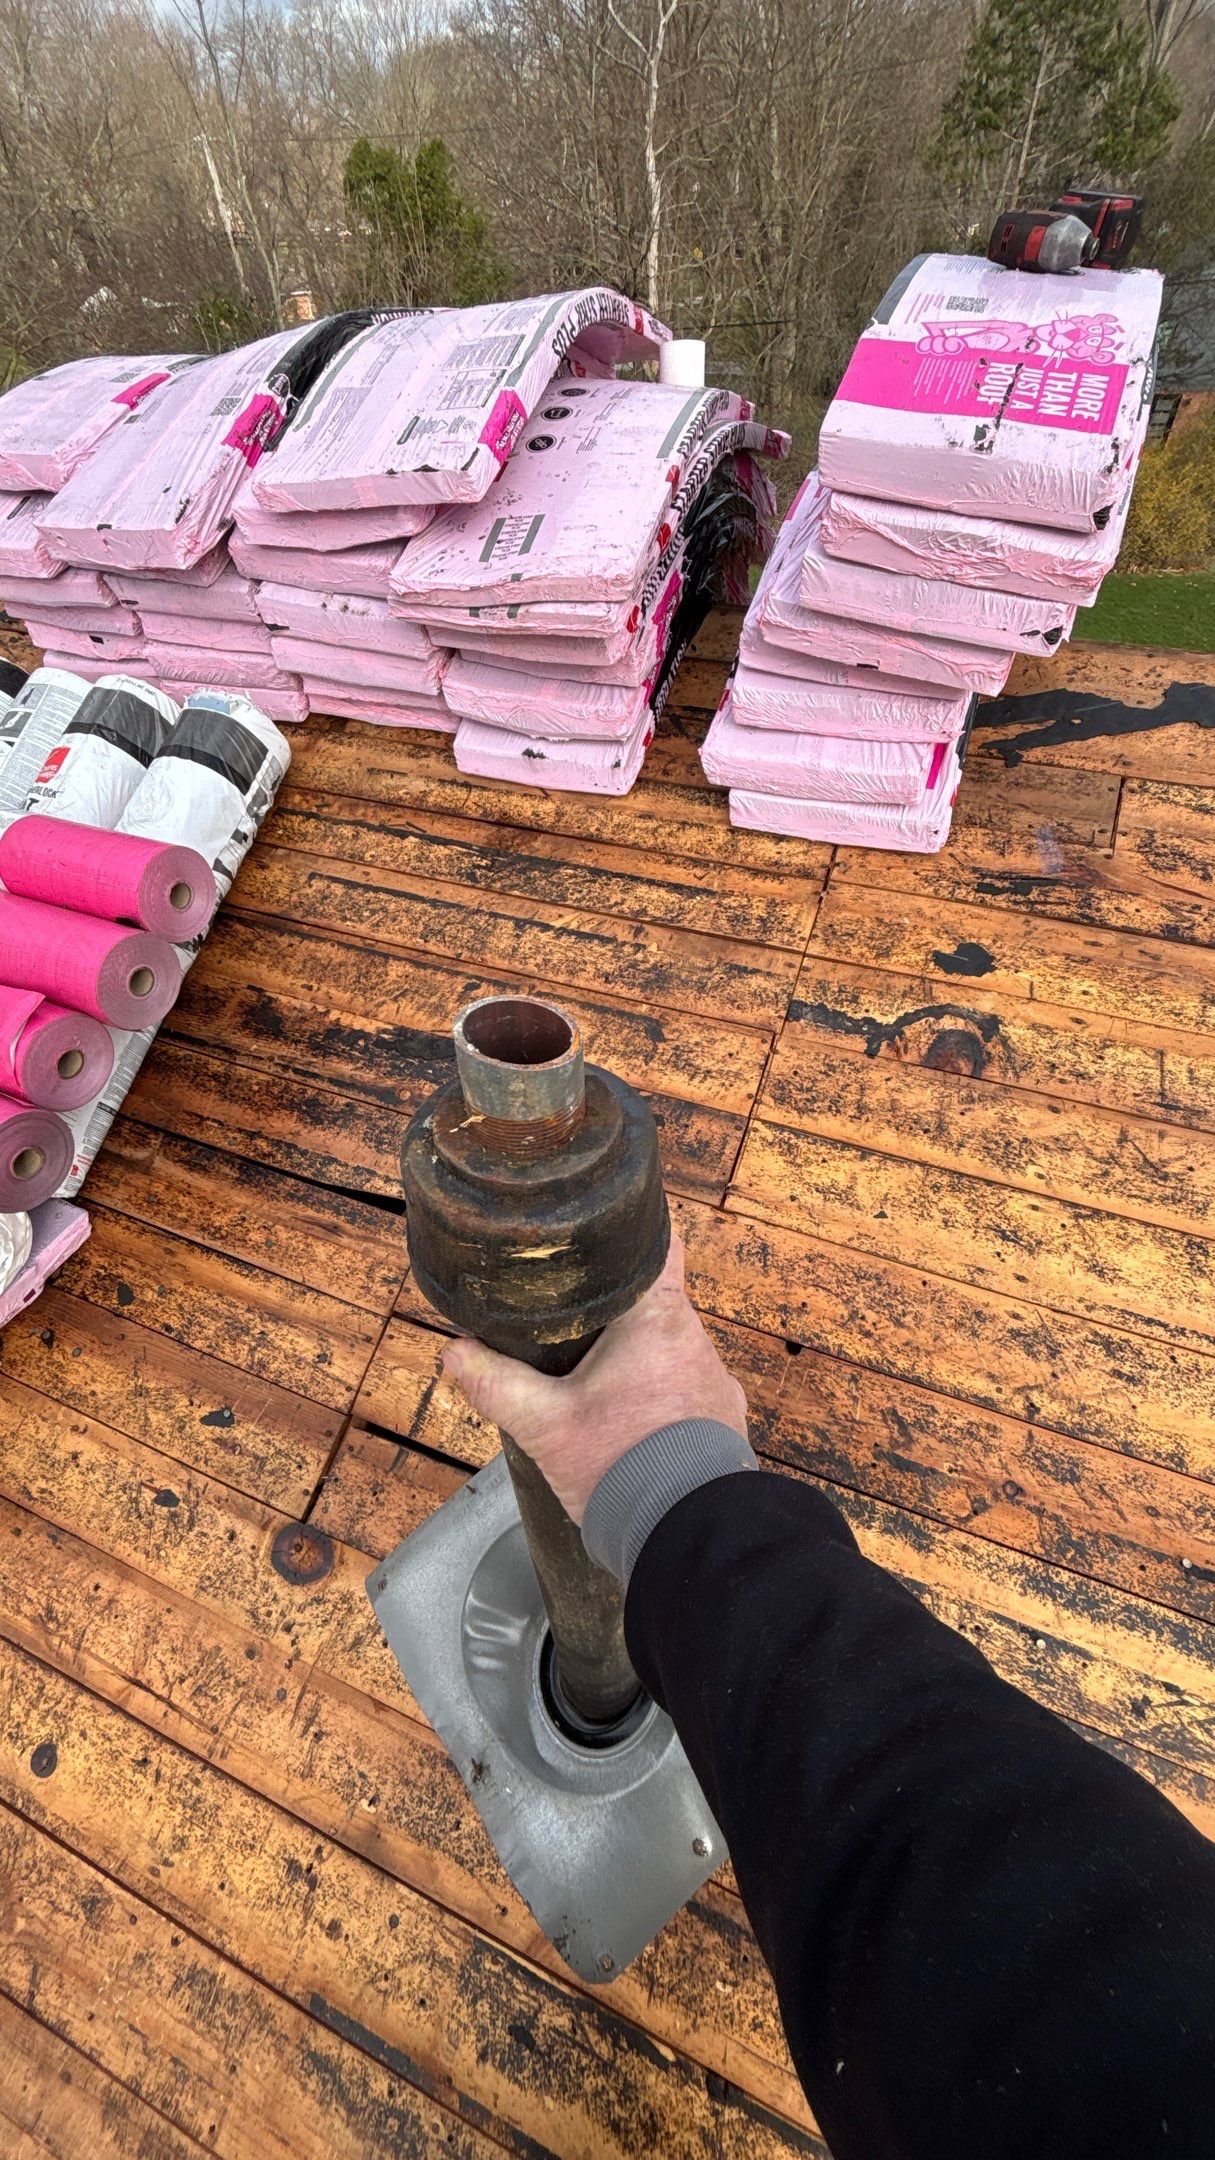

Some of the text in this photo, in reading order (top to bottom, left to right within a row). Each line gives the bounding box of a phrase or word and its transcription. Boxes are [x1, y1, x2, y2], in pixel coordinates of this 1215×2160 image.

[976, 361, 1018, 405] ROOF
[1014, 368, 1045, 399] JUST
[1037, 371, 1077, 417] THAN
[1071, 372, 1110, 422] MORE
